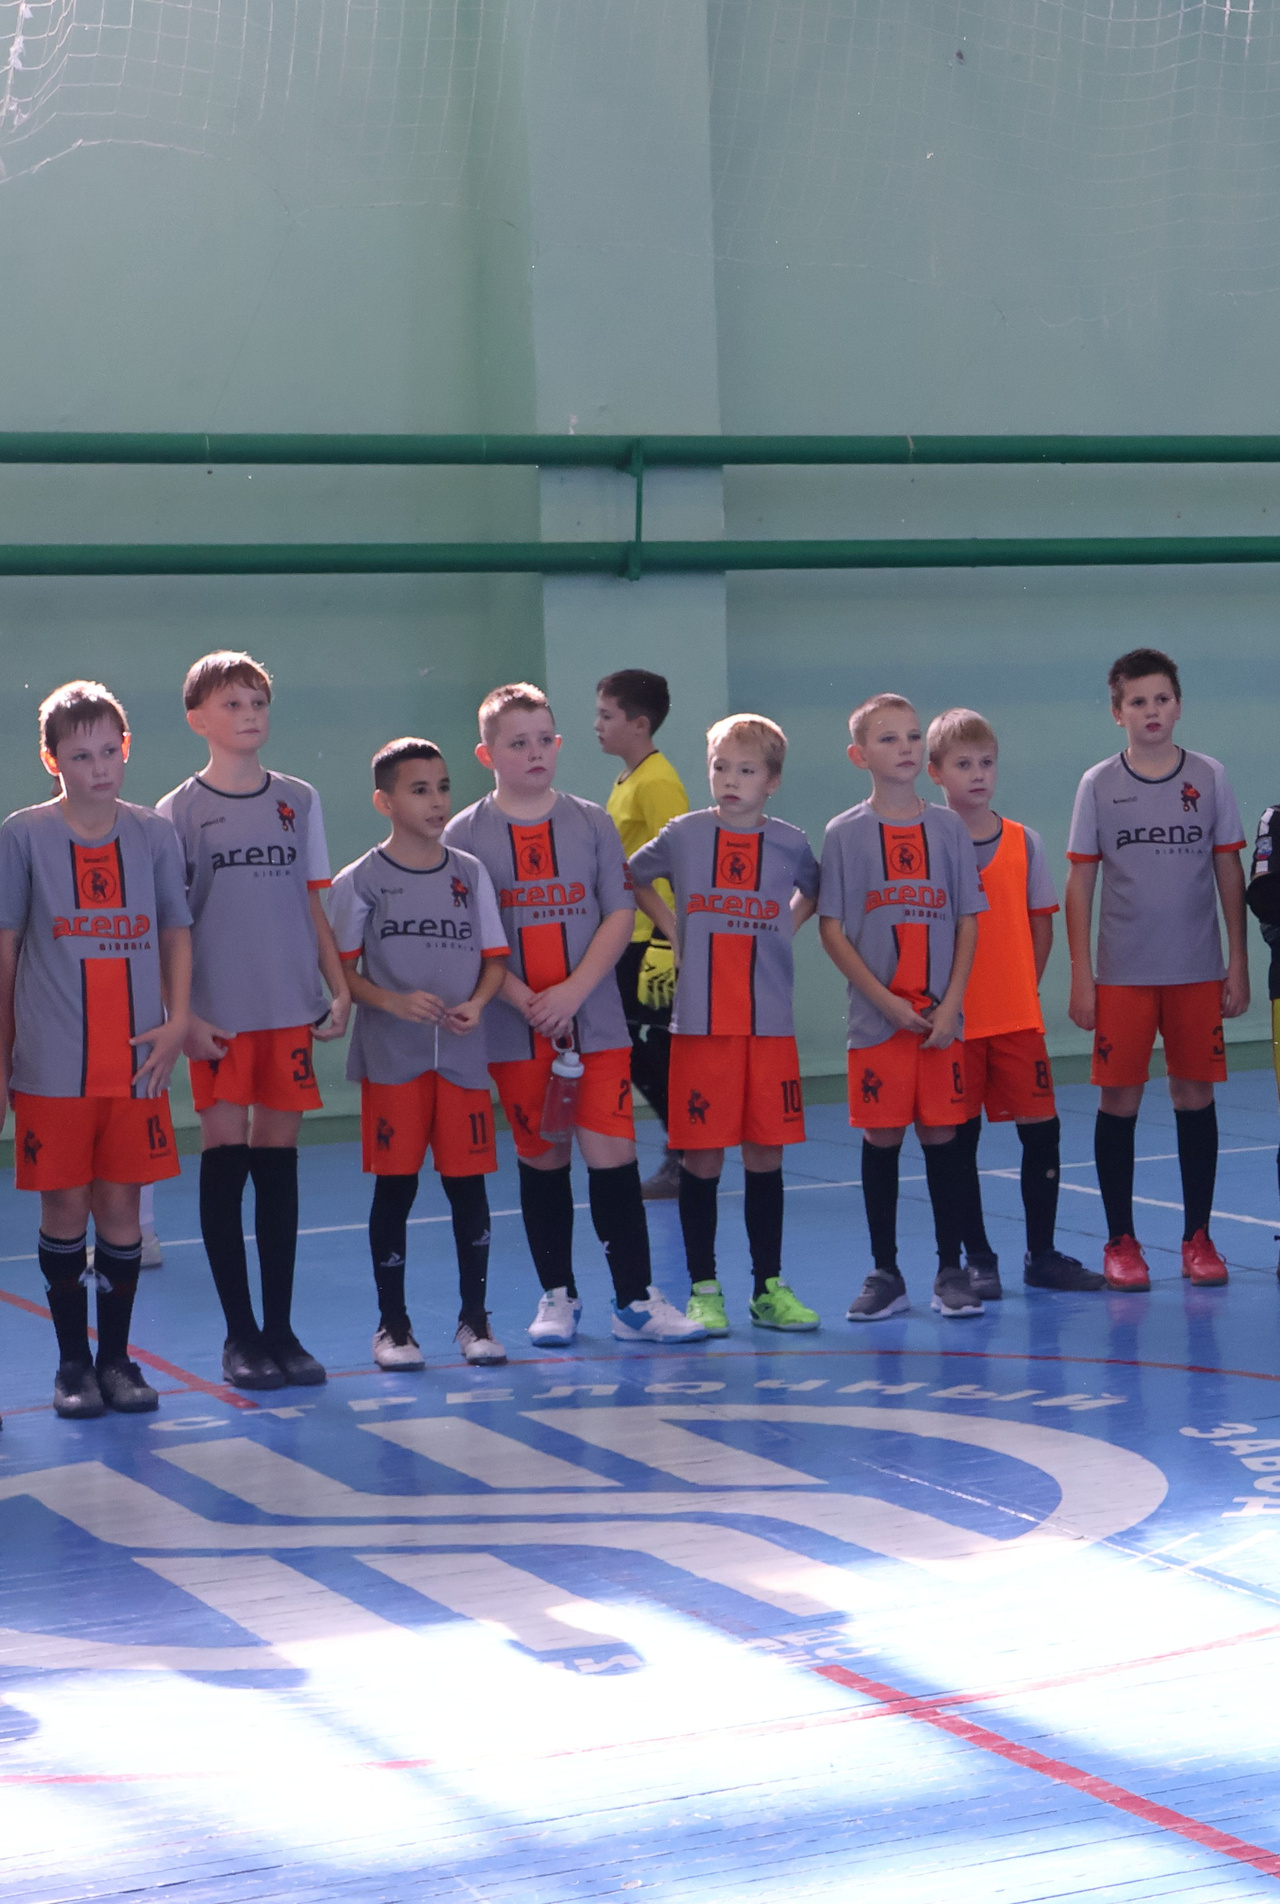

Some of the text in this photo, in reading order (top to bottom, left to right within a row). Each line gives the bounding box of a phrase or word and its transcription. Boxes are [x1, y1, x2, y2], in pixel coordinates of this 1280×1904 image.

[1116, 825, 1204, 851] arena
[211, 845, 297, 875] arena
[686, 893, 780, 920] arena
[865, 885, 947, 915] arena
[52, 914, 150, 941] arena
[381, 919, 473, 941] arena
[291, 1047, 310, 1082] 3
[1035, 1060, 1049, 1089] 8
[781, 1079, 802, 1114] 10
[469, 1111, 487, 1145] 11
